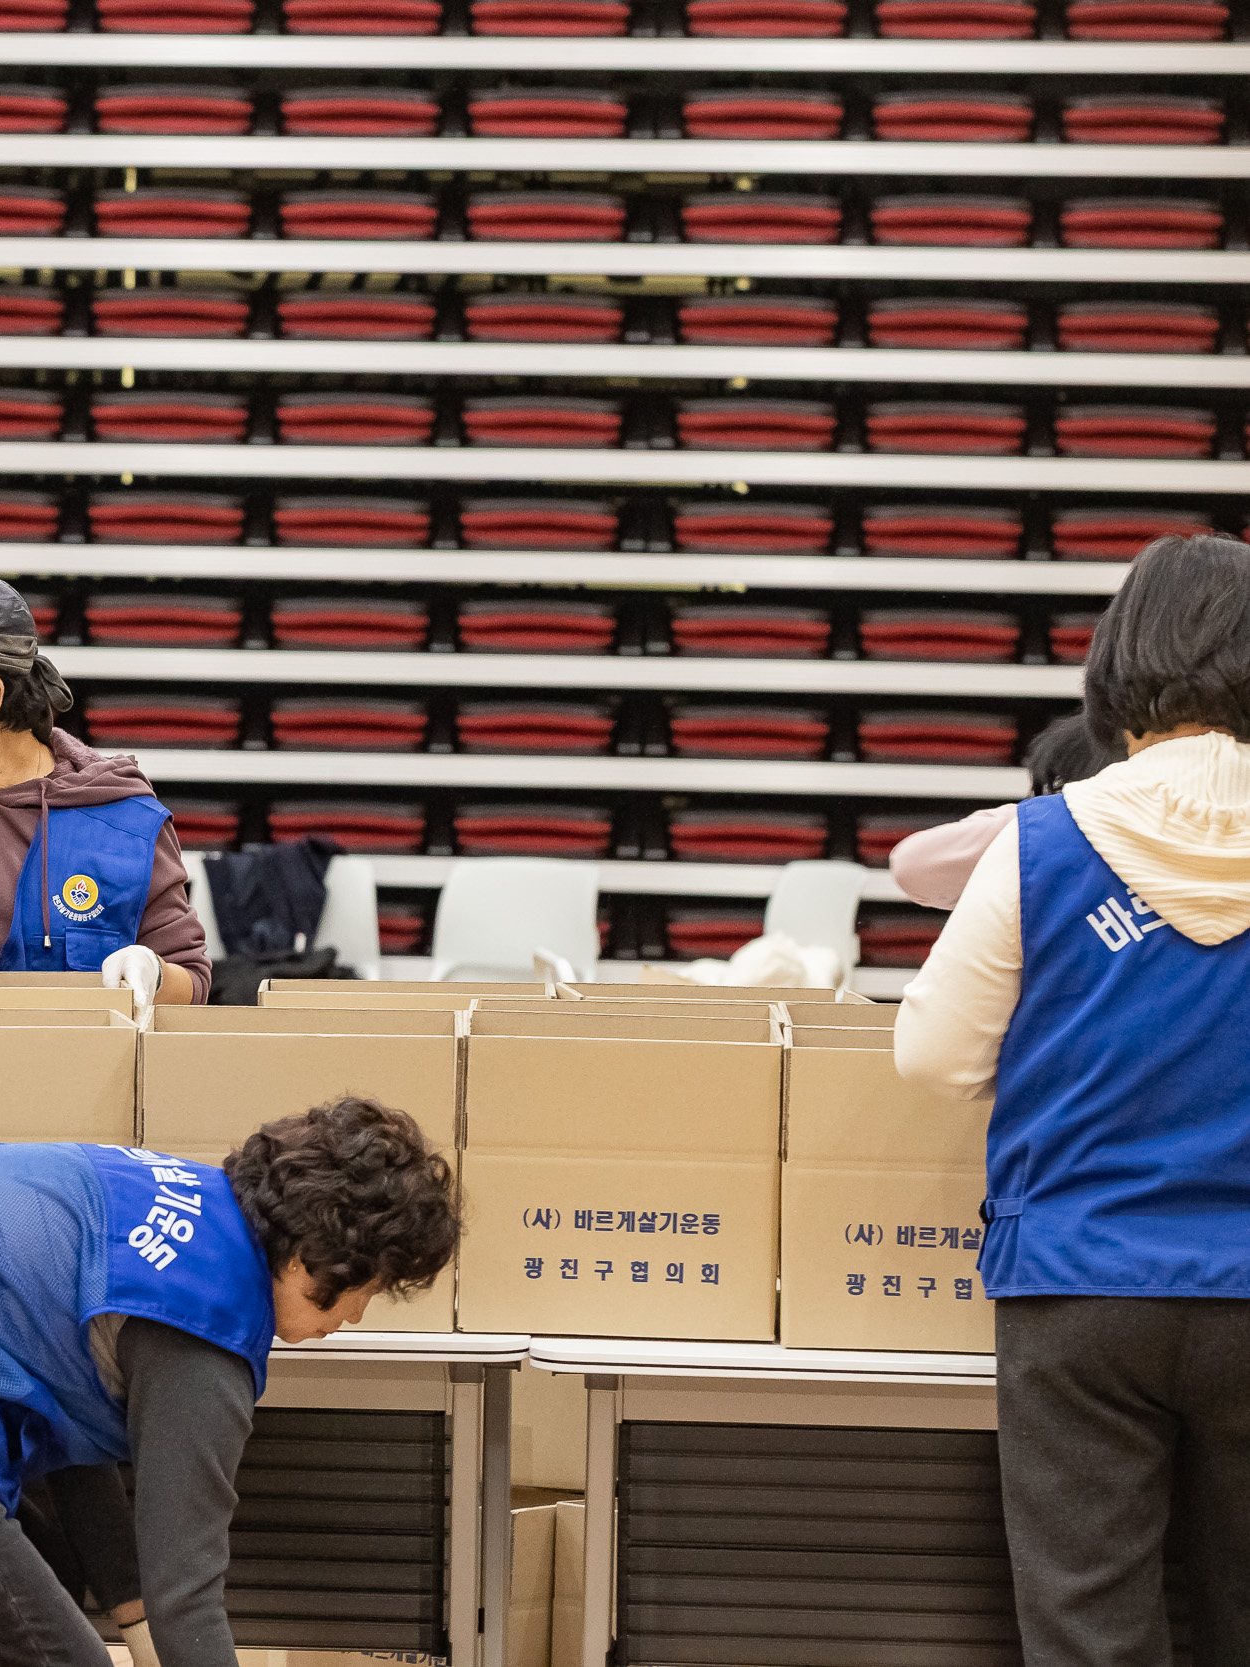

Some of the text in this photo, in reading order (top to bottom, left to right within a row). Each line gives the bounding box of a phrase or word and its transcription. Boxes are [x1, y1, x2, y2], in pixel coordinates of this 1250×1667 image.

[522, 1208, 721, 1236] (사) 바르게살기운동
[845, 1223, 883, 1246] (사)
